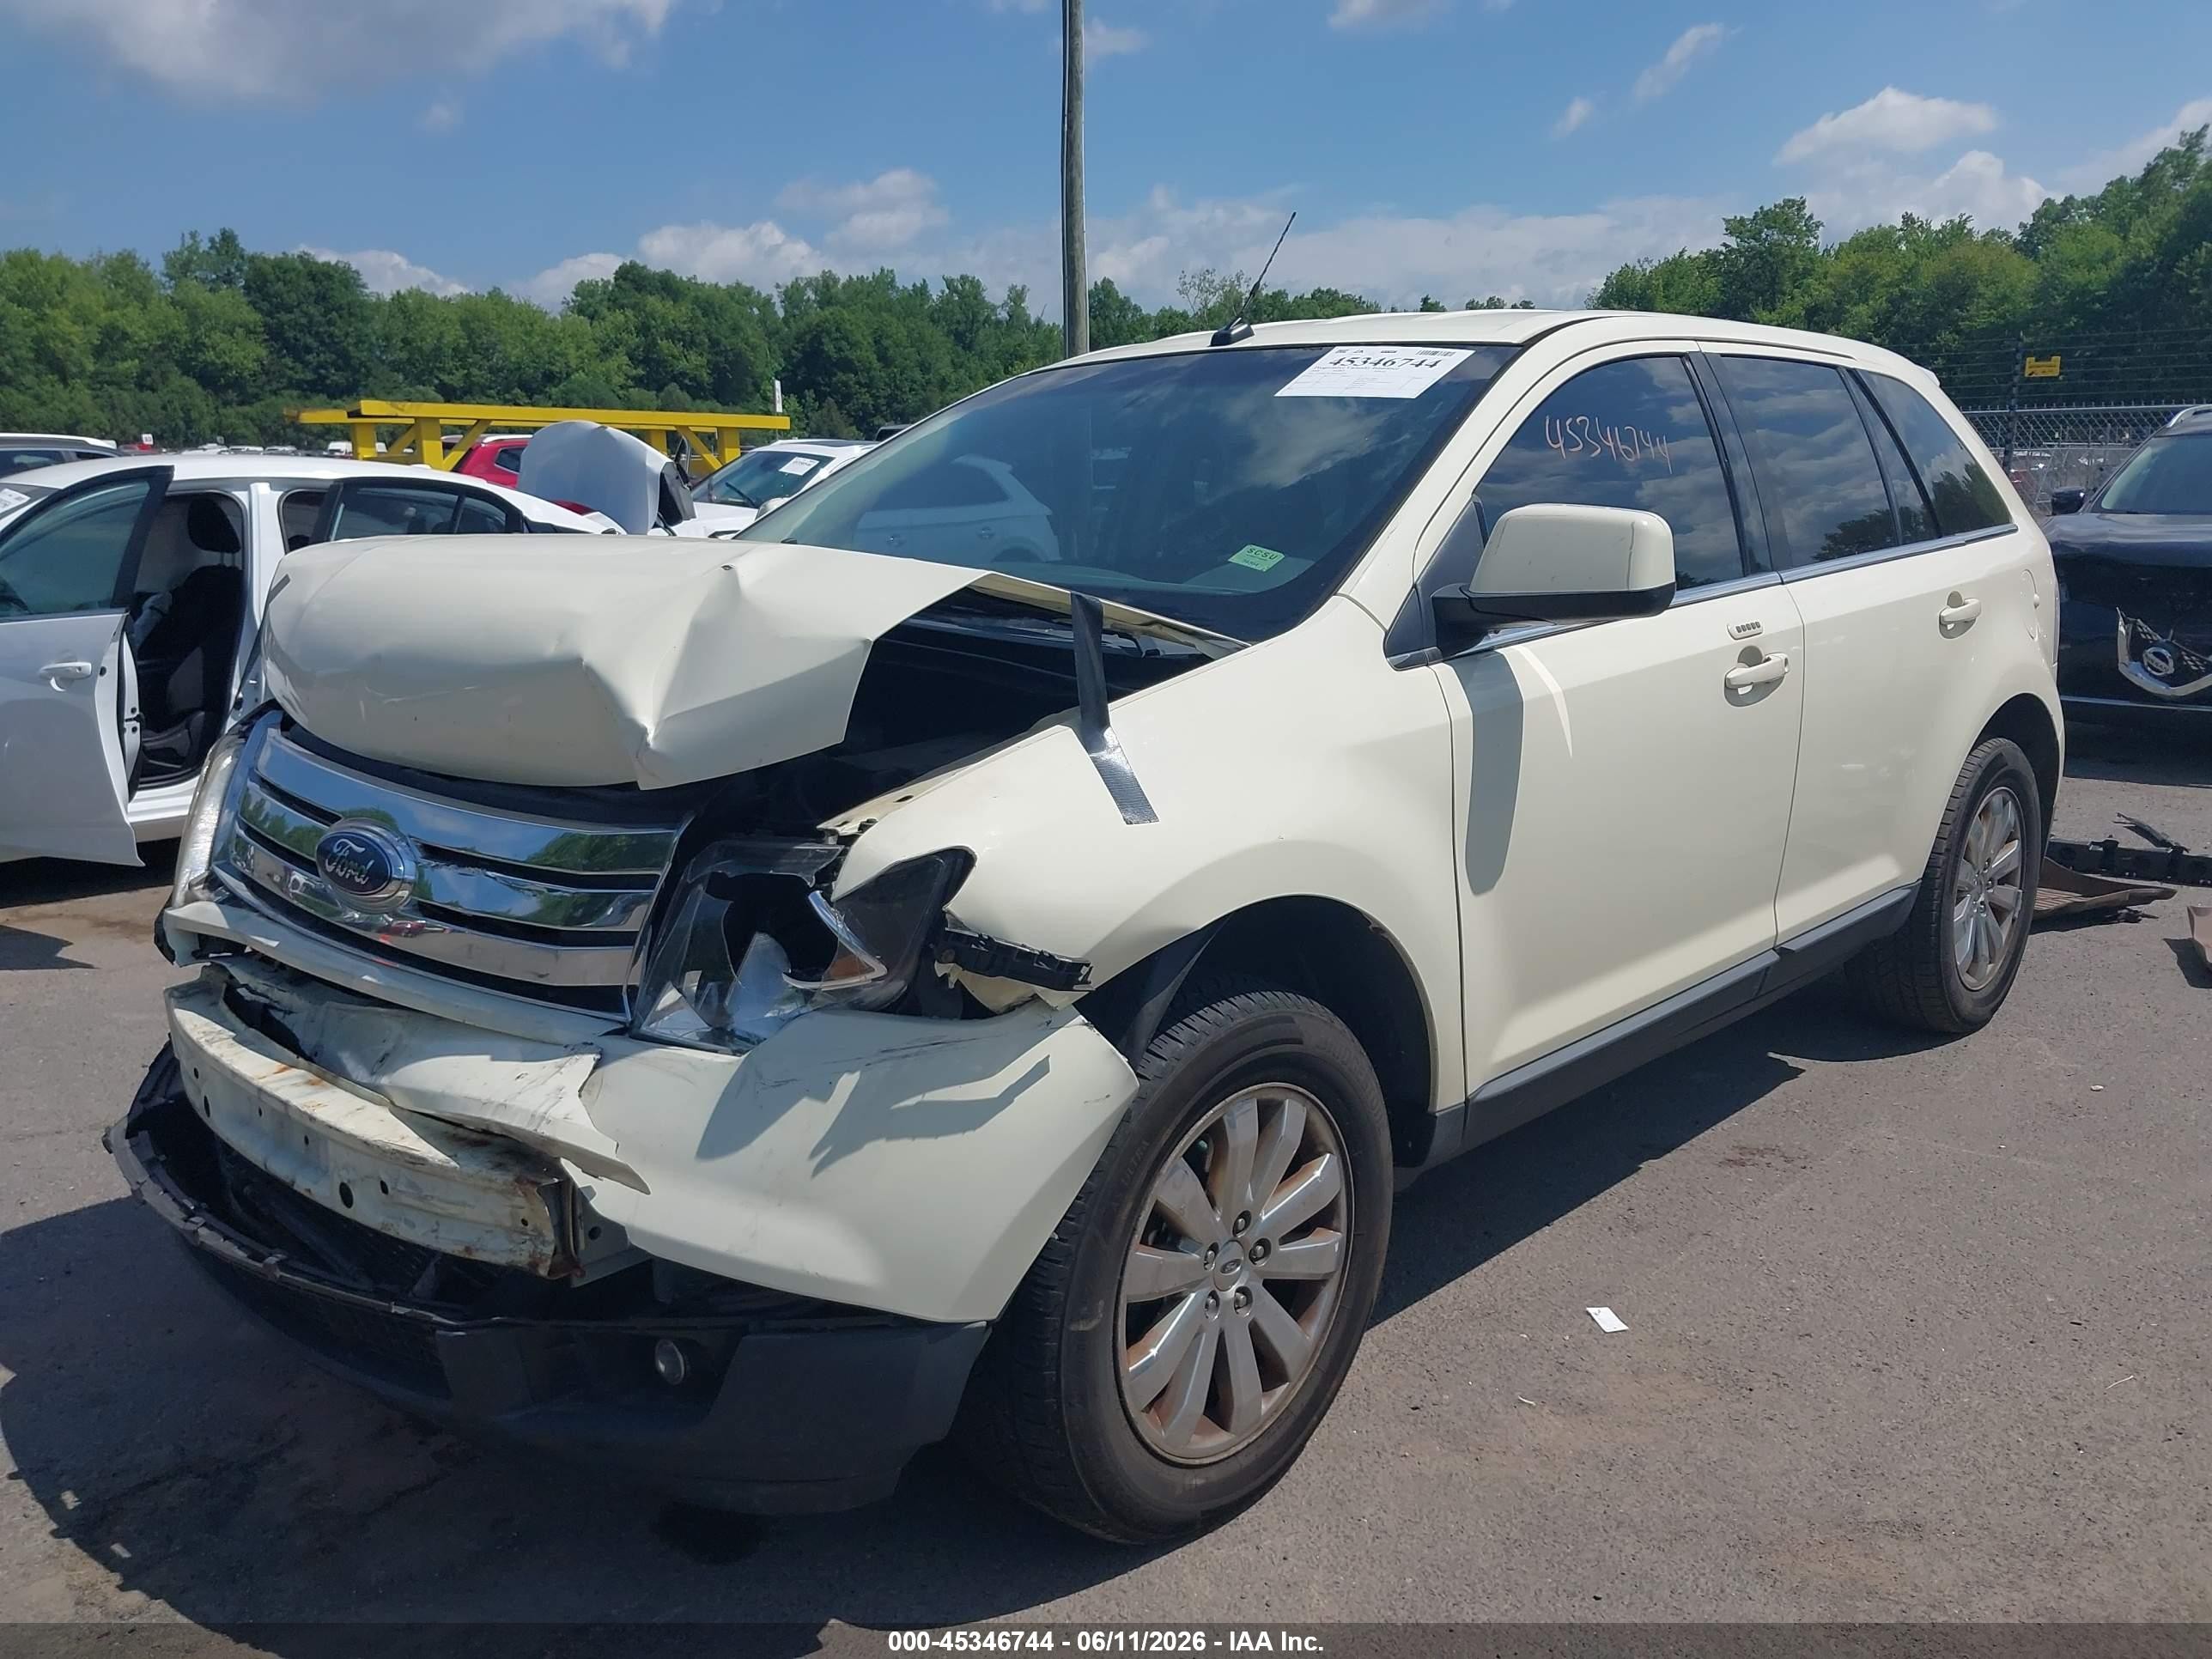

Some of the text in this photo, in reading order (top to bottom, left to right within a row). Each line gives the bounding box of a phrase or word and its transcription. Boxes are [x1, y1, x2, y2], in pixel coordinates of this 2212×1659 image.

[1329, 356, 1442, 368] 45346744
[1545, 415, 1673, 475] 45346744
[325, 838, 376, 885] Ford
